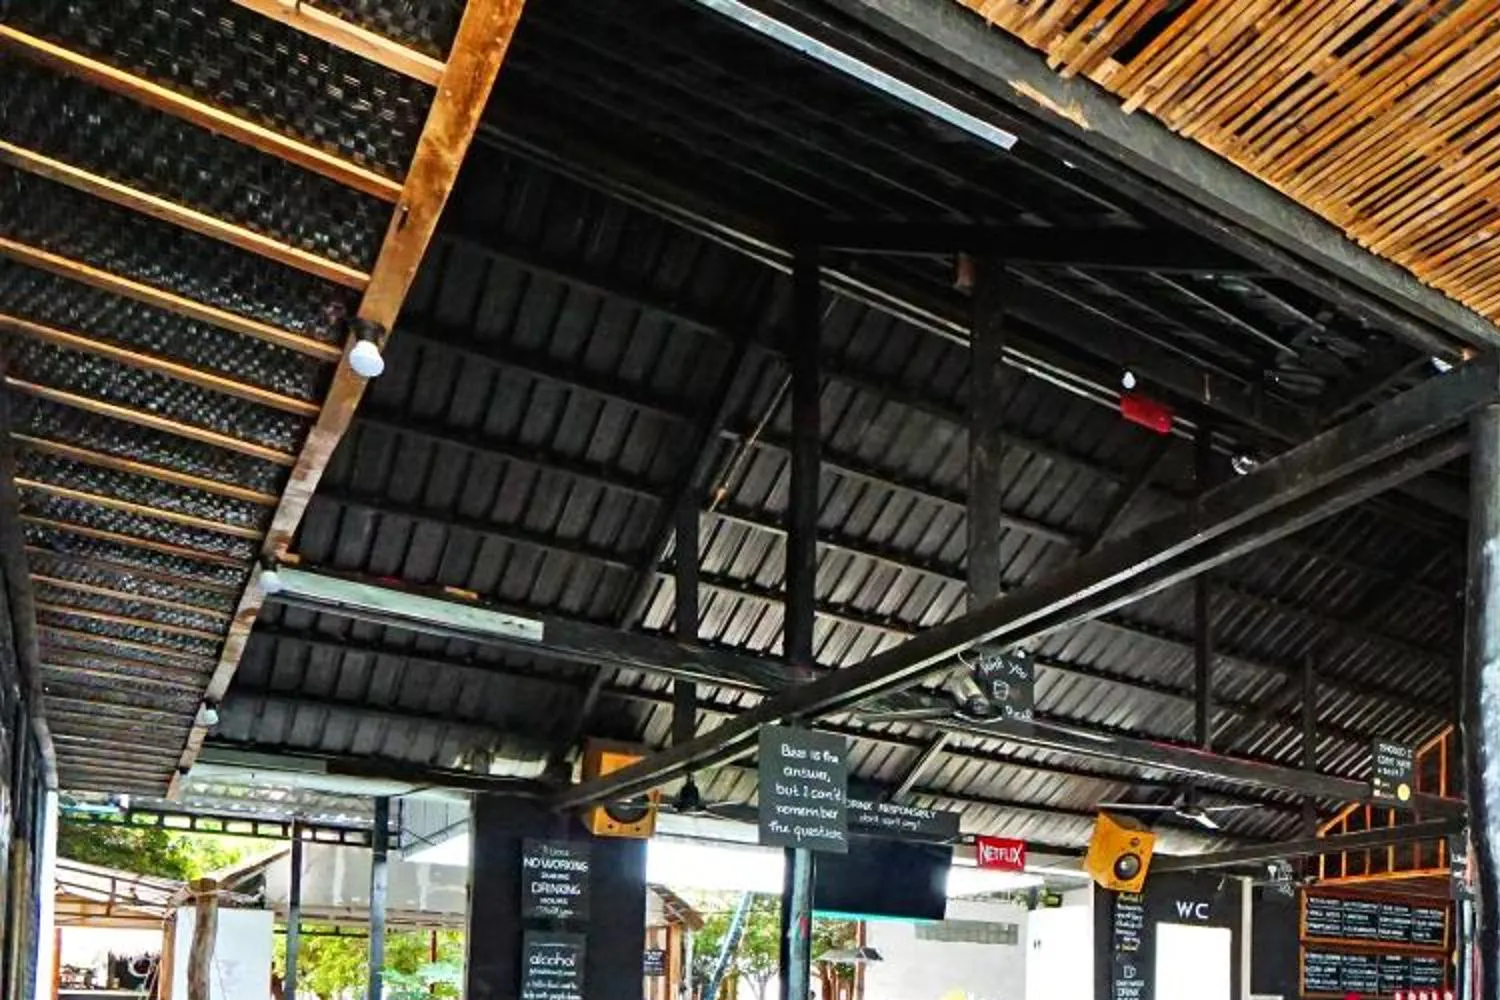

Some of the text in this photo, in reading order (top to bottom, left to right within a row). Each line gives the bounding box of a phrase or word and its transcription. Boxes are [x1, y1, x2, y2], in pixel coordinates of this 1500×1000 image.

[775, 782, 800, 798] but
[879, 803, 937, 819] RESPONSIBLY
[979, 840, 1024, 867] NETFLIX
[523, 856, 589, 872] NO WORKING
[531, 881, 581, 895] DRINKING
[1175, 900, 1209, 919] WC
[528, 951, 577, 967] alcohol
